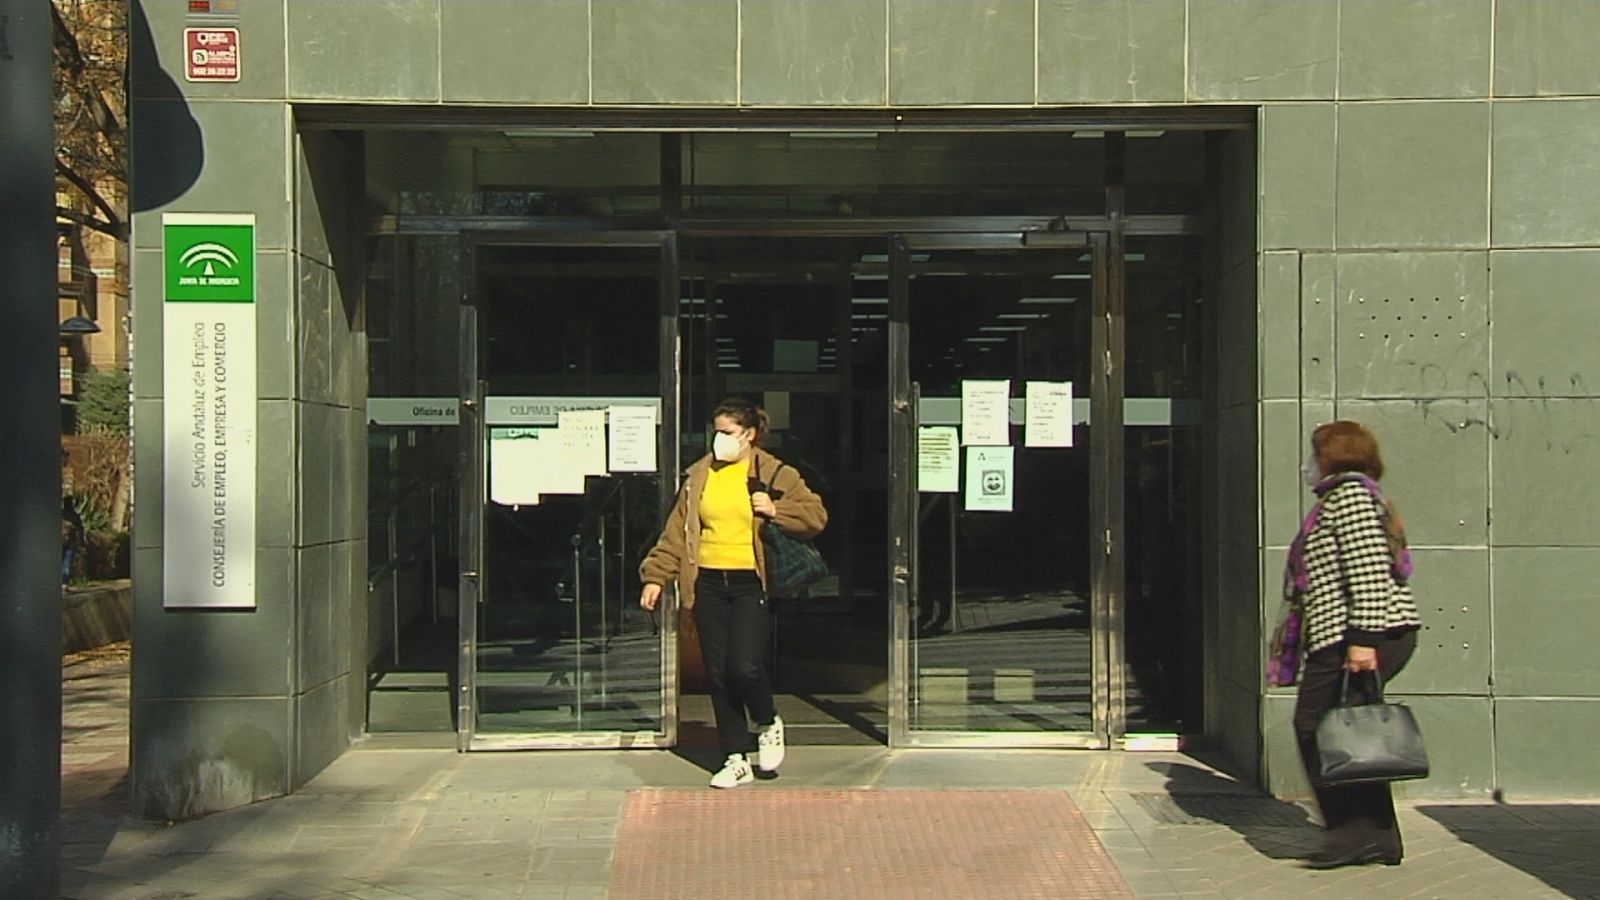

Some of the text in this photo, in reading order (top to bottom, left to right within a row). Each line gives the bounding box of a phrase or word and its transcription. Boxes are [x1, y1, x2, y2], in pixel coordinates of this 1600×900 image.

[214, 322, 226, 383] COMERCIO
[191, 322, 208, 488] Servicio Andaluz de Empleo
[214, 394, 226, 447] EMPRESA
[413, 406, 455, 416] Oficina de
[214, 449, 228, 498] EMPLEO,
[214, 500, 226, 516] DE
[211, 518, 226, 588] CONSEJERÍA
